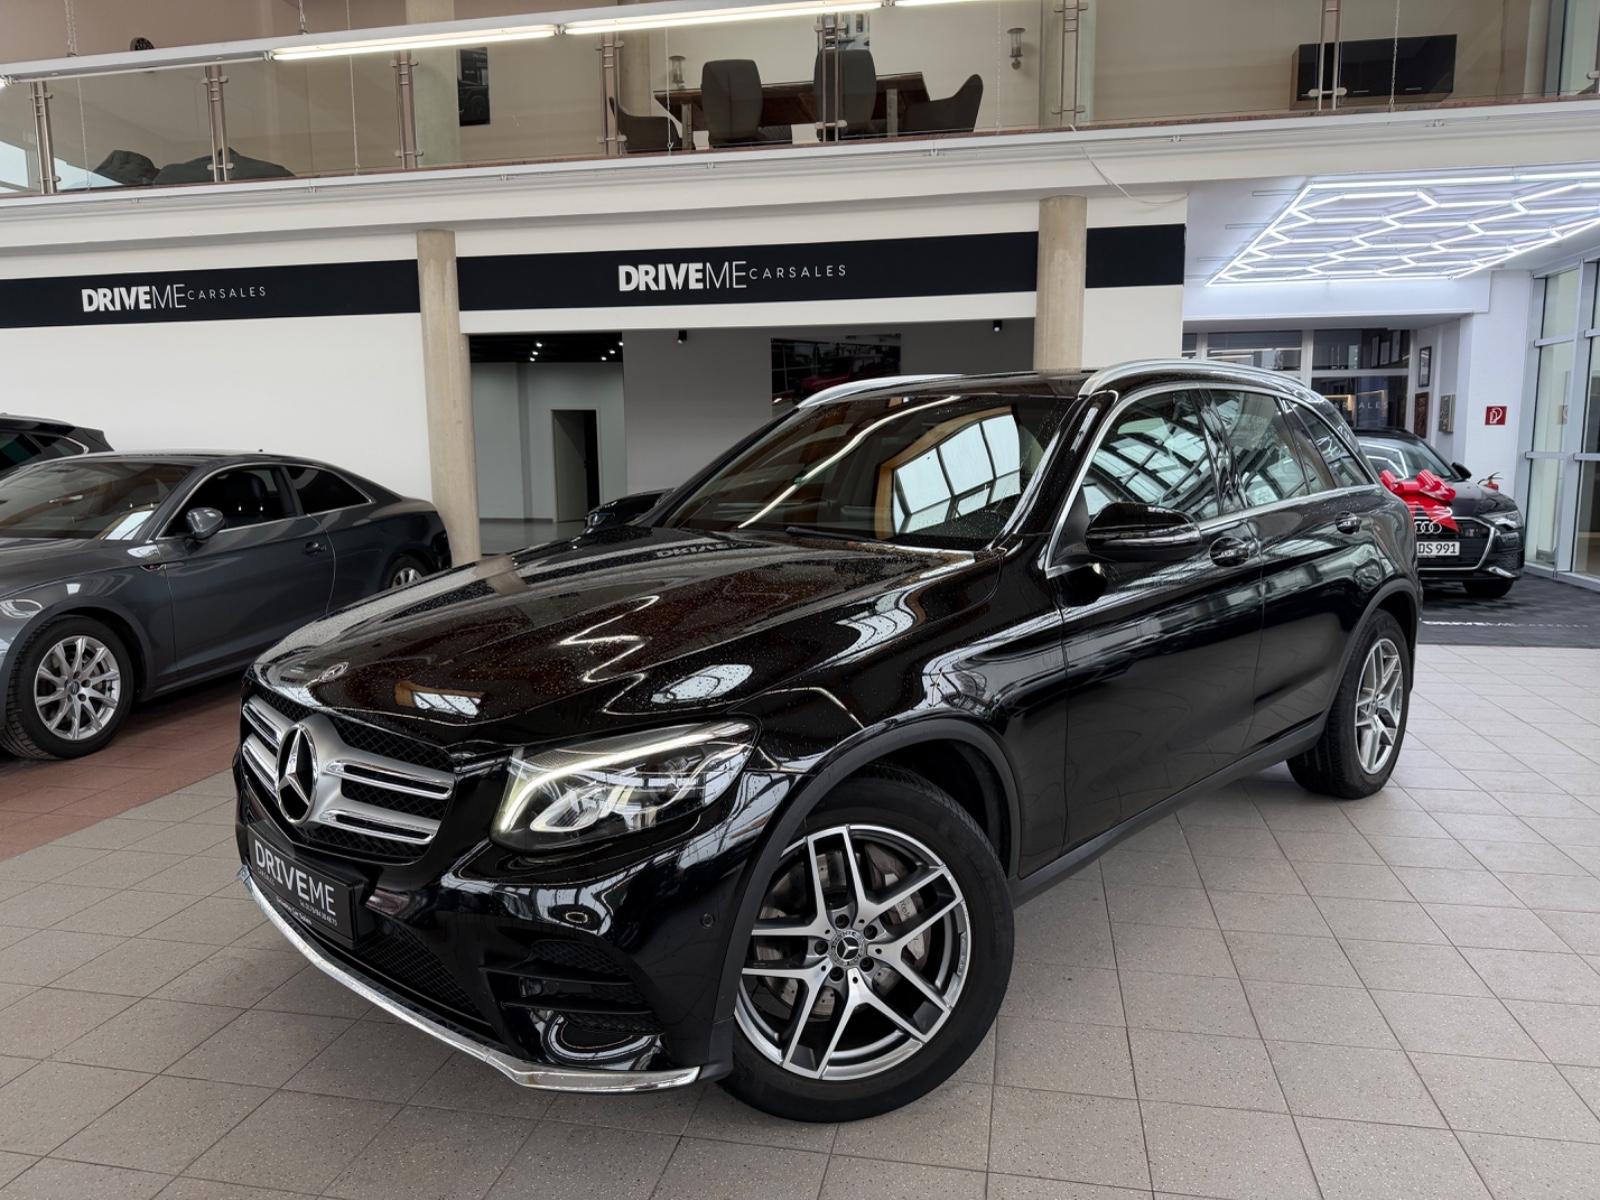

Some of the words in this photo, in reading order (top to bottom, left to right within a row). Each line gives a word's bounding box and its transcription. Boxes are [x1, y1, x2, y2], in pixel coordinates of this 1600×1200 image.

[749, 264, 847, 279] CARSALES
[187, 286, 267, 300] CARSALES
[1435, 543, 1457, 554] 991
[254, 840, 337, 916] DRIVEME
